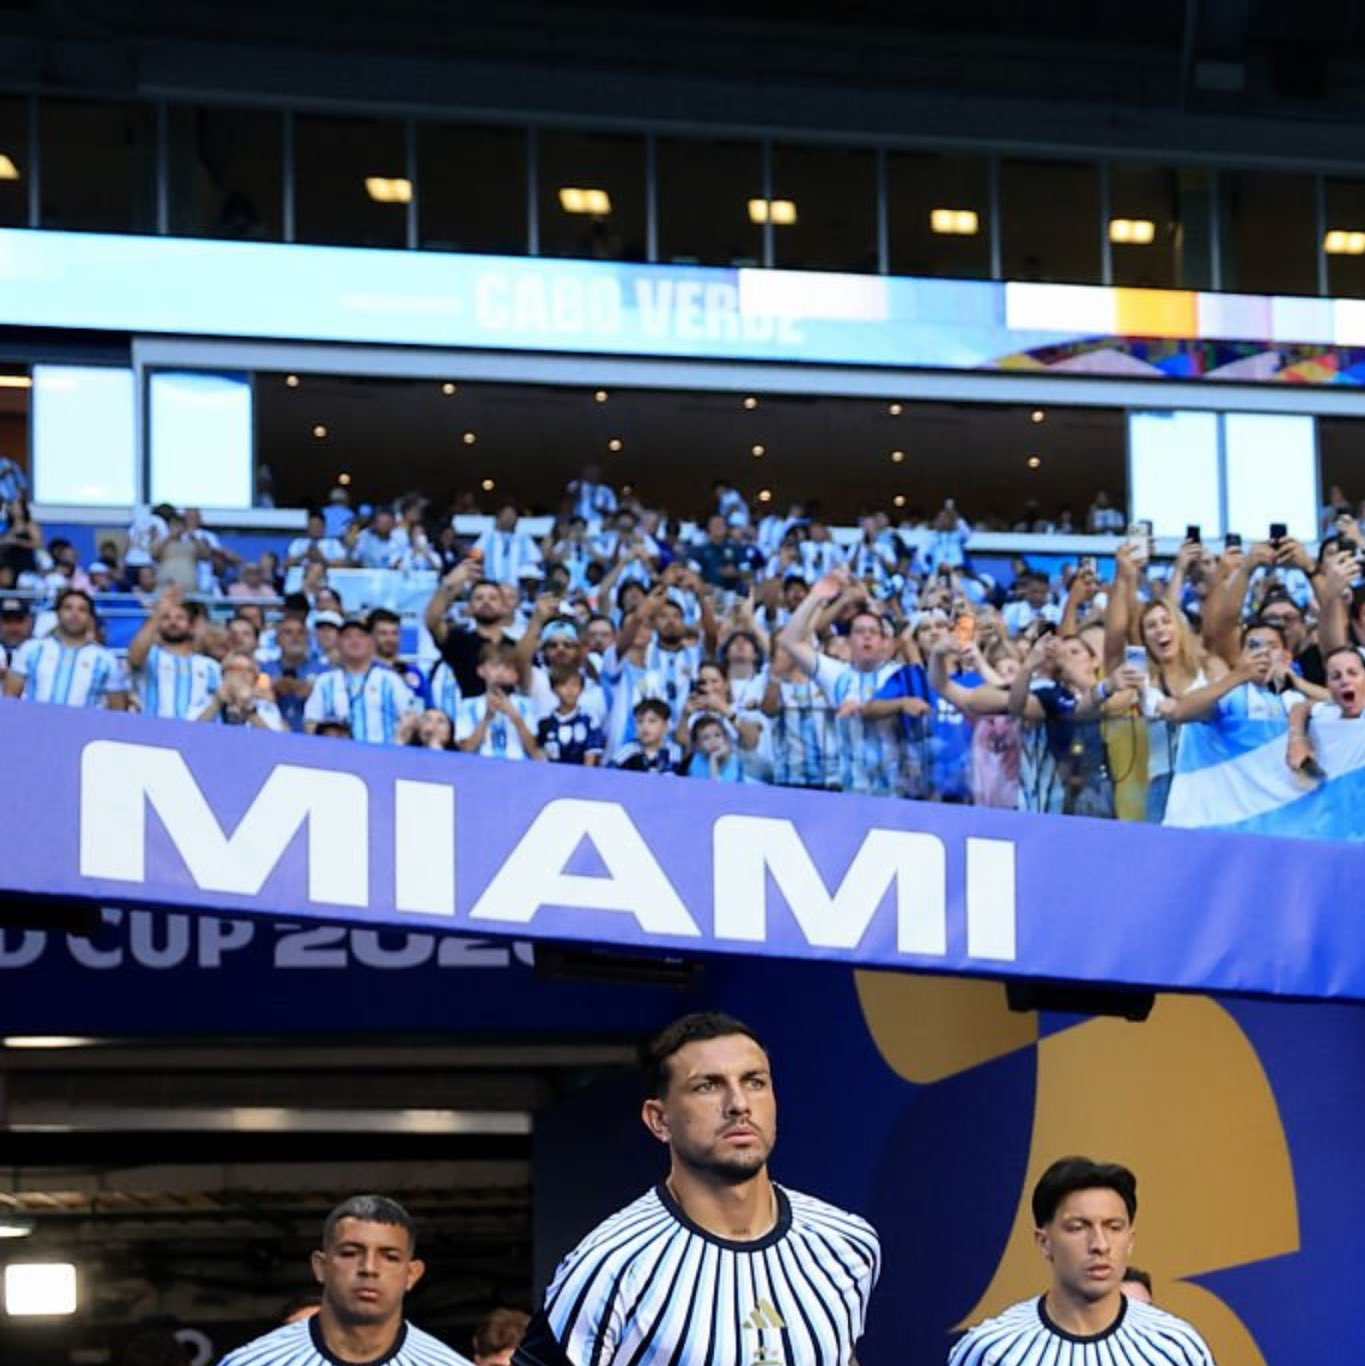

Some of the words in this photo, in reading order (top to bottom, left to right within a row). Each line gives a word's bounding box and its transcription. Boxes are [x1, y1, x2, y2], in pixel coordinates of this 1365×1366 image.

[474, 271, 620, 332] CABO
[80, 740, 1017, 962] MIAMI
[67, 907, 254, 968] CUP
[274, 922, 536, 968] 202
